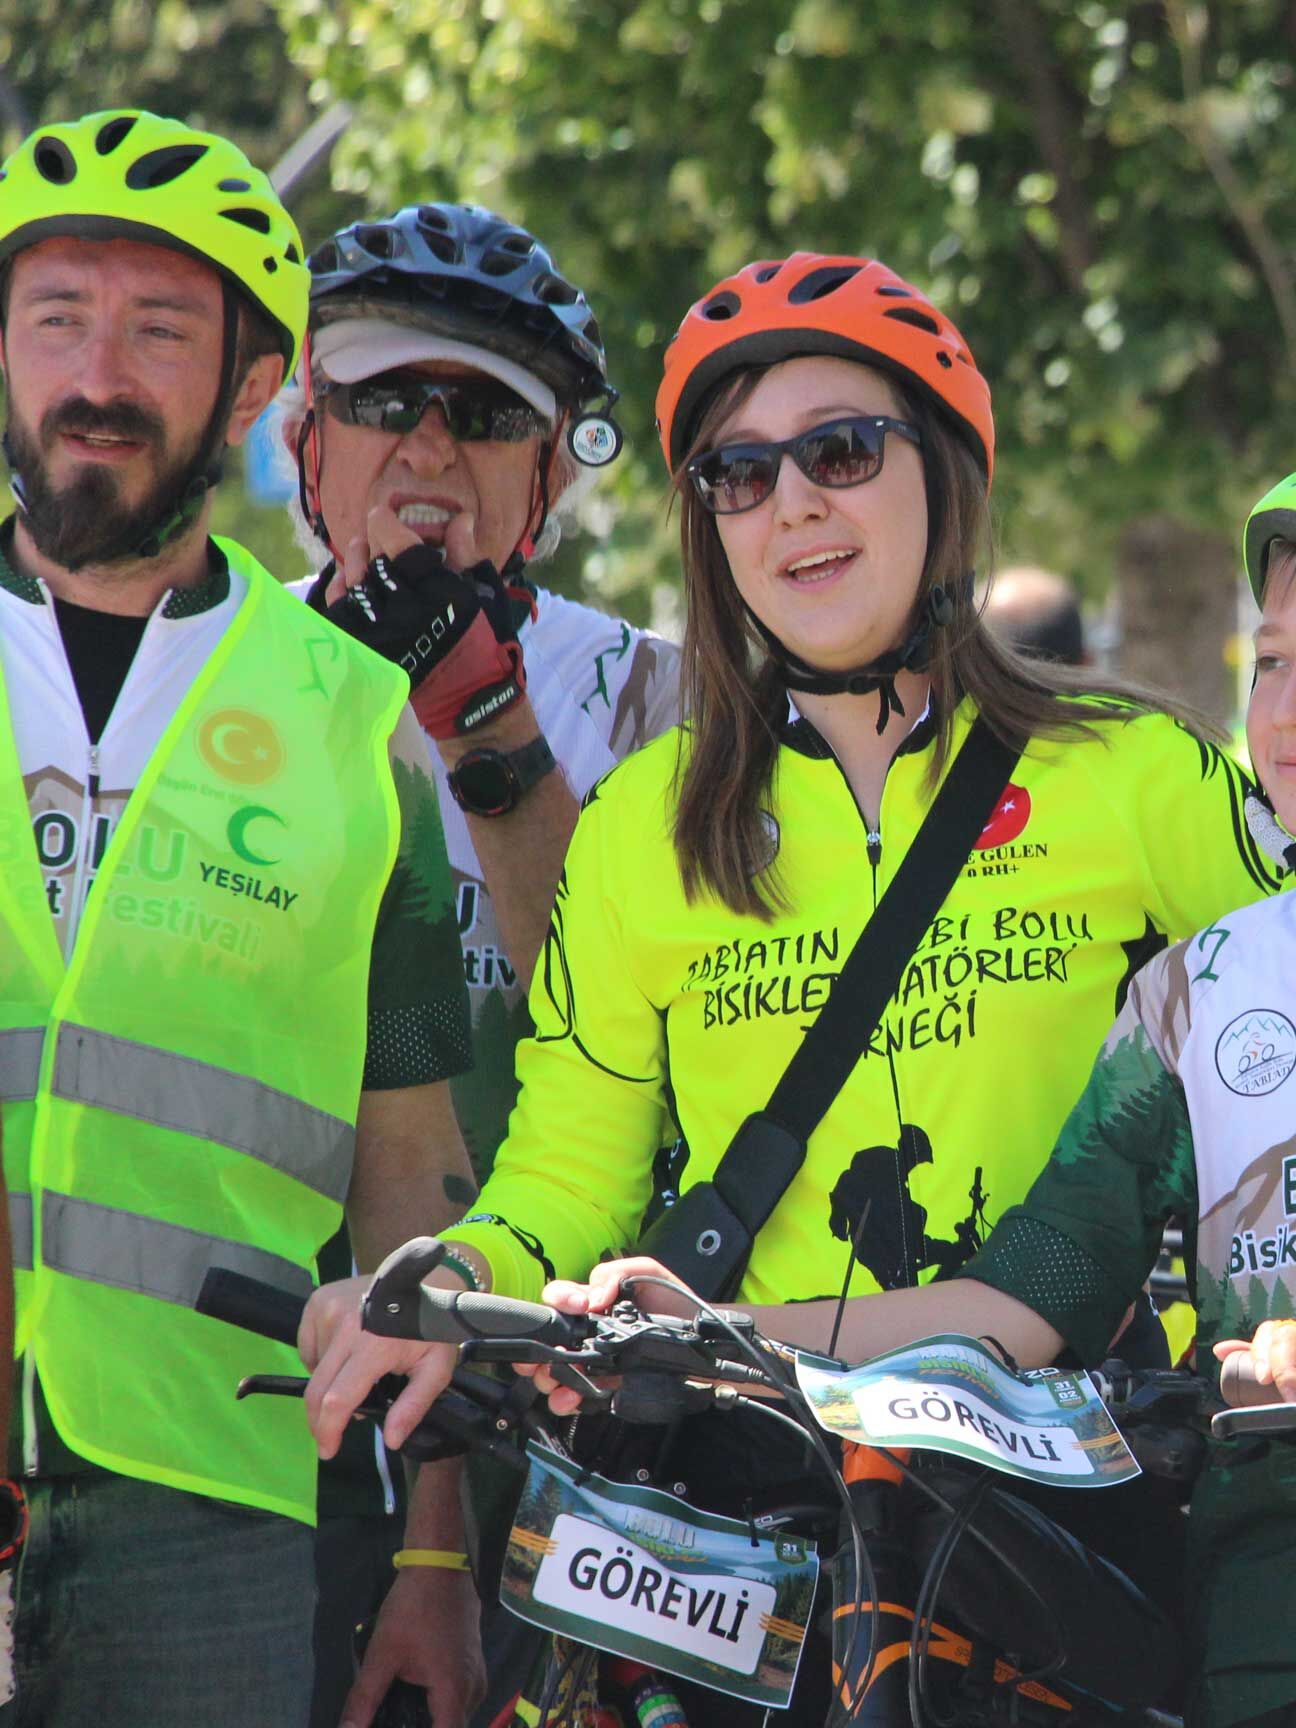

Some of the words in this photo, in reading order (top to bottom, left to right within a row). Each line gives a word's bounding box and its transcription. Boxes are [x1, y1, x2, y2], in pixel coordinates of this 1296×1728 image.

[0, 811, 186, 881] OLU
[982, 863, 1021, 877] RH+
[87, 879, 261, 960] estivali
[993, 907, 1094, 941] BOLU
[893, 942, 1077, 1007] ATÖRLERİ
[888, 1391, 1062, 1463] GÖREVLİ
[567, 1546, 751, 1644] GÖREVLİ
